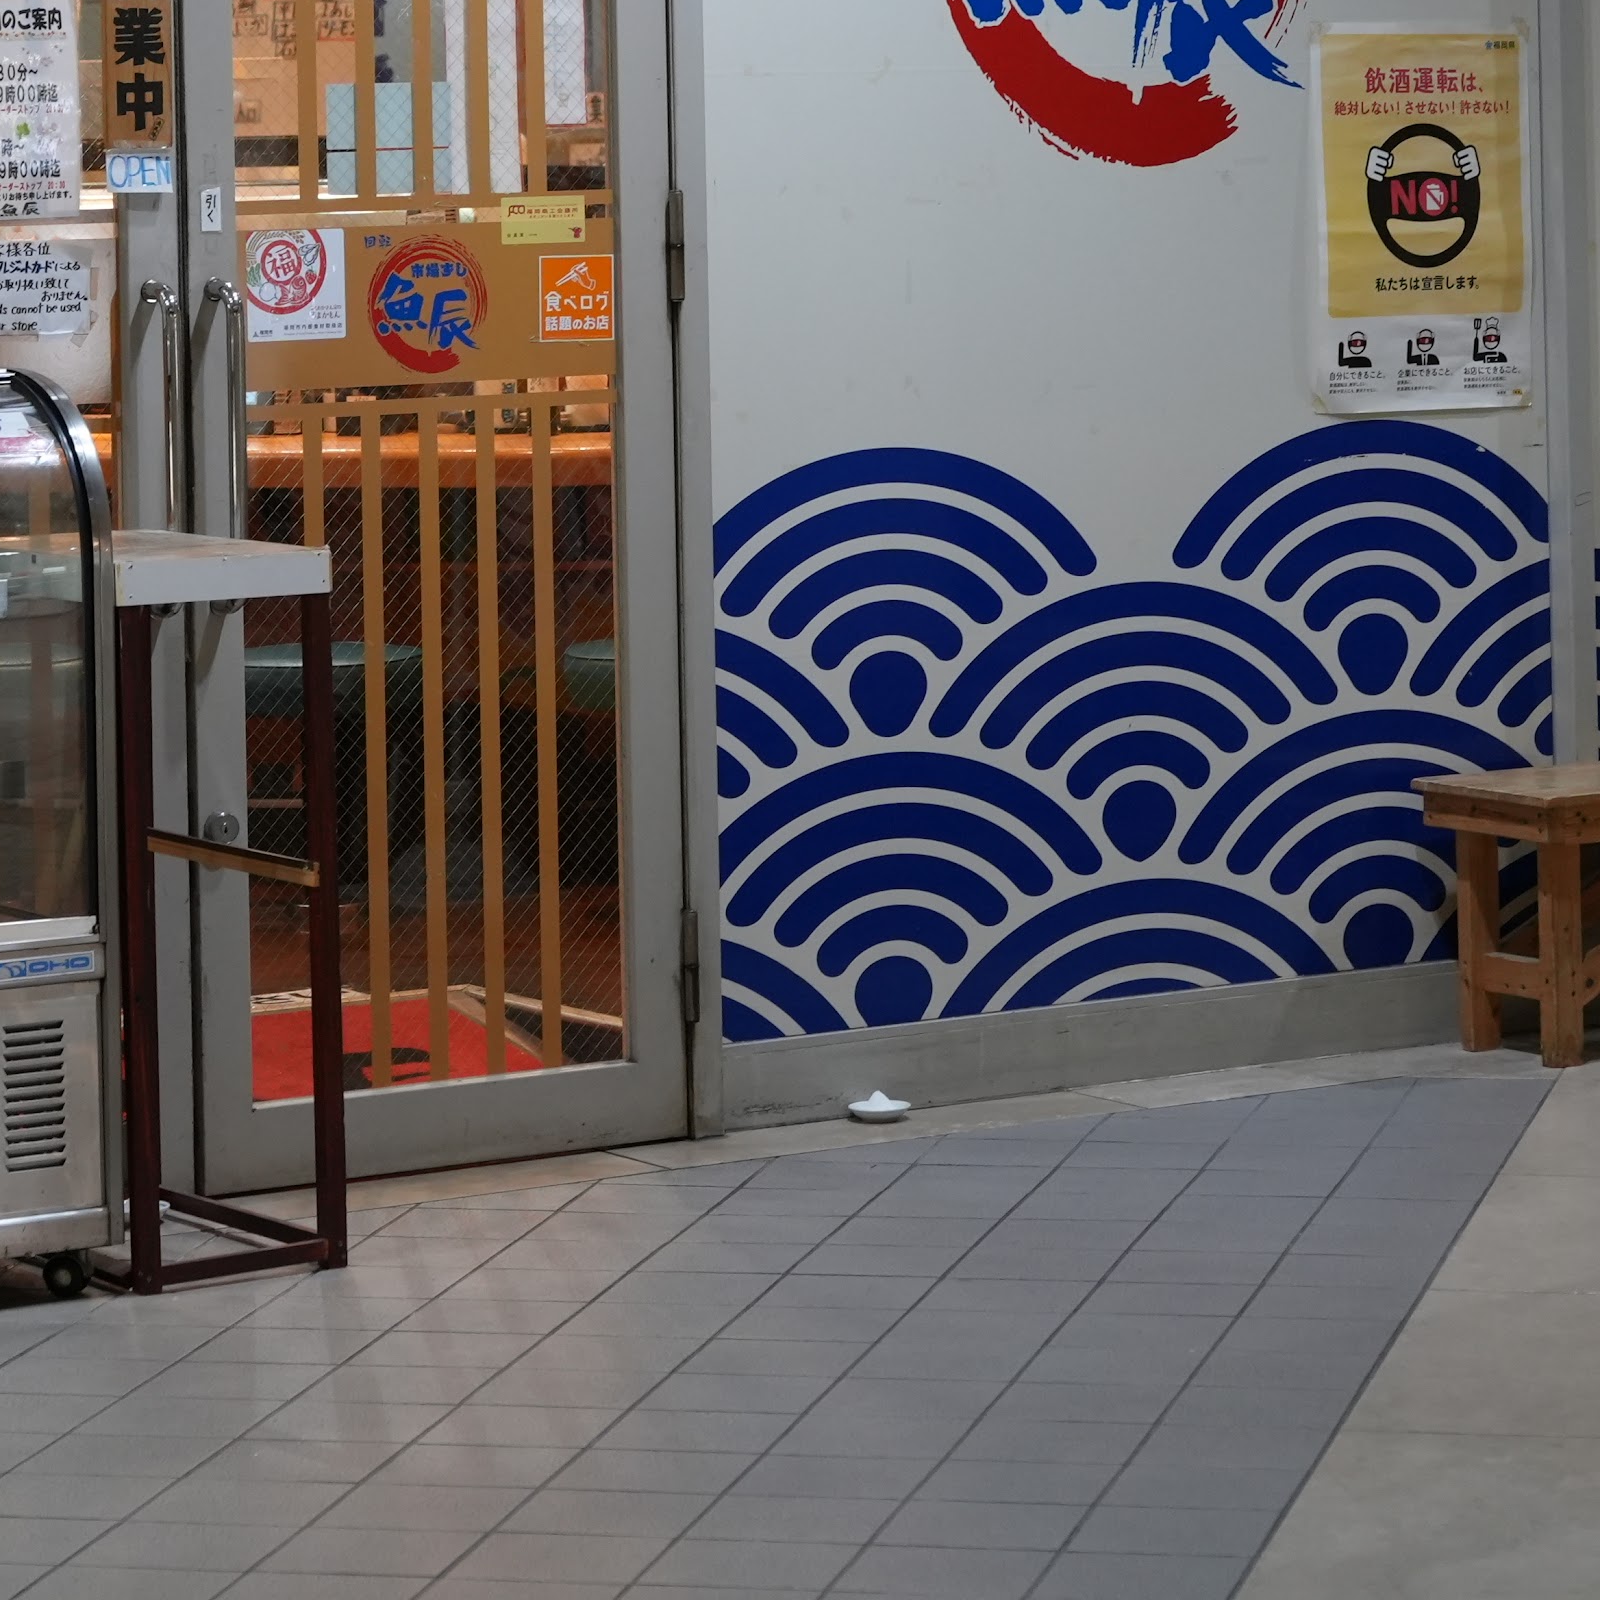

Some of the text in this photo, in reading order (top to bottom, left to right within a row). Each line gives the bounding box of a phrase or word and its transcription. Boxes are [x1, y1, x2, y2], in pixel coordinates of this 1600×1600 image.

[1493, 40, 1515, 49] 福岡県
[1364, 67, 1485, 94] 飲酒運転は、
[1334, 100, 1510, 116] 絶対しない! させない! 許さない!
[109, 155, 171, 189] OPEN
[0, 201, 40, 216] 魚辰
[205, 194, 217, 224] 引く
[363, 235, 391, 250] 回転
[267, 246, 297, 278] 福
[410, 261, 468, 279] 市場ずし
[1375, 275, 1480, 291] 私たちは宣言します。
[41, 291, 87, 302] おりません。
[544, 291, 609, 312] 食べログ
[11, 304, 43, 315] cannot
[46, 303, 57, 313] be
[60, 303, 81, 313] used
[378, 272, 479, 351] 魚辰
[545, 315, 609, 331] 話題のお店
[1329, 369, 1386, 381] 自分にできること。
[1397, 367, 1453, 378] 企業にできること。
[1463, 365, 1521, 376] お店にできること。
